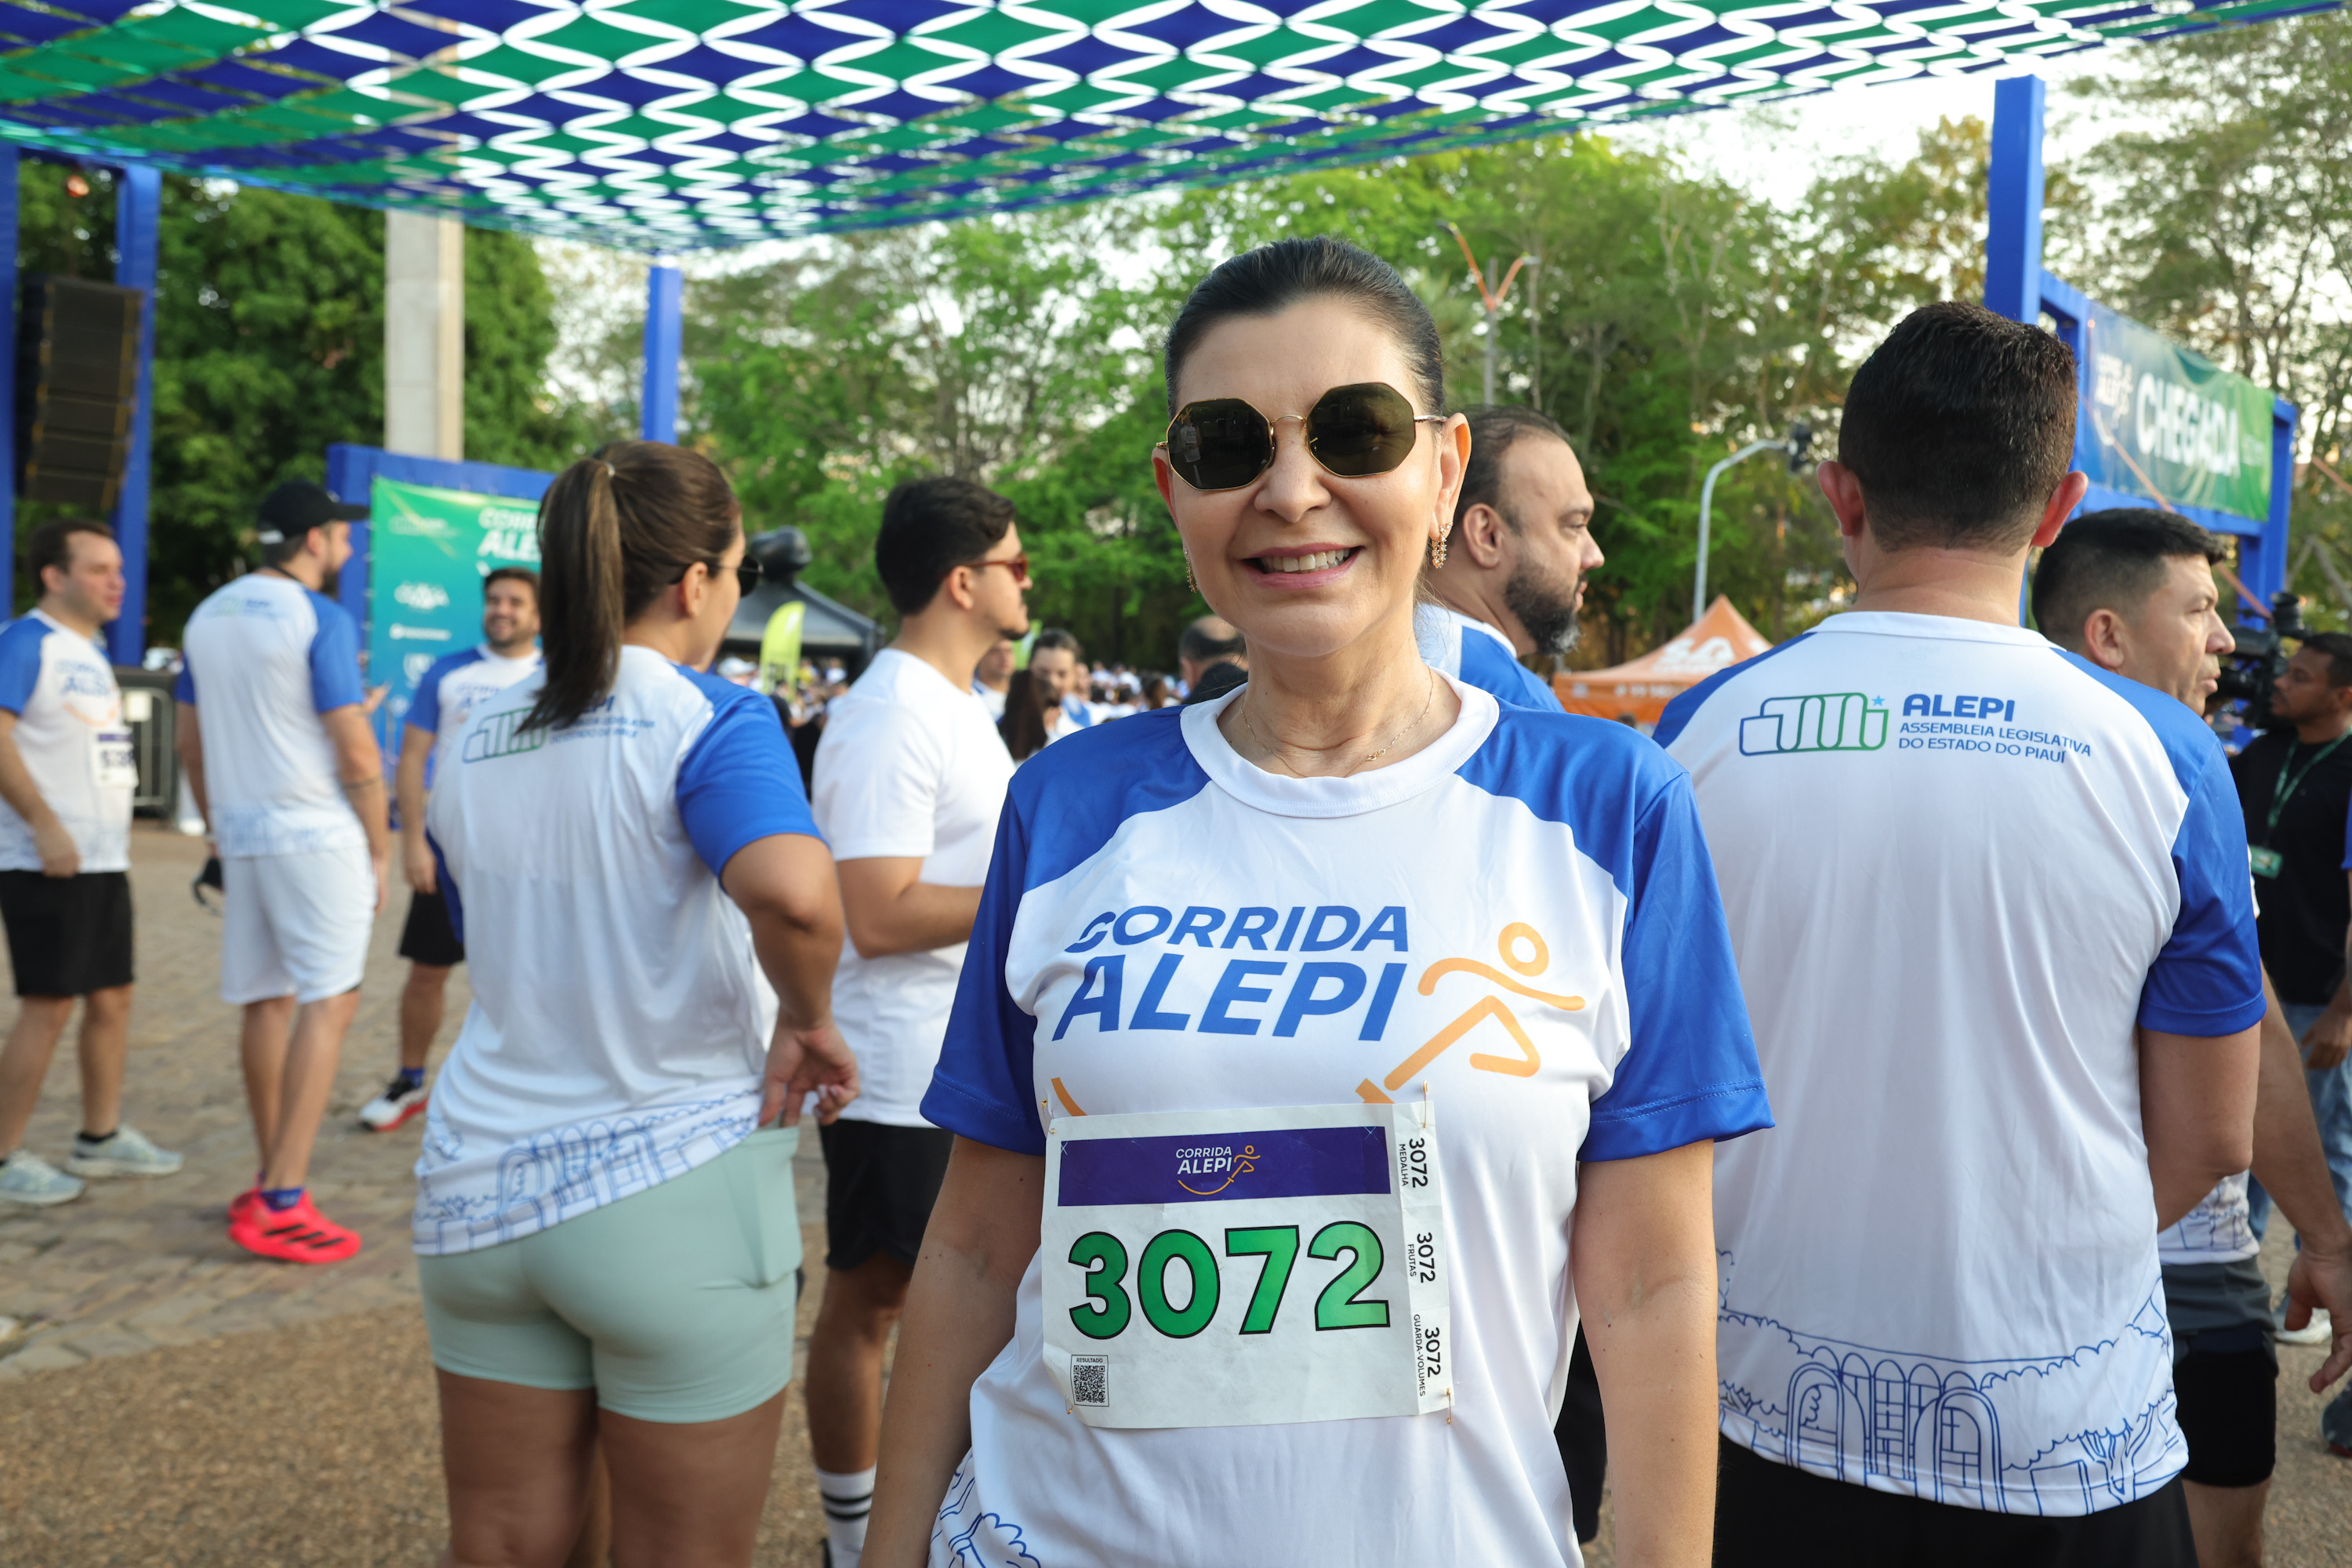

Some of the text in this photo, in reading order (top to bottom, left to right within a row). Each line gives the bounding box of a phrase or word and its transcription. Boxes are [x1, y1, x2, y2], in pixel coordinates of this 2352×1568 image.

[2136, 372, 2240, 479] CHEGADA
[476, 528, 543, 563] ALE
[1903, 694, 2015, 722] ALEPI
[1899, 738, 2067, 763] DO ESTADO DO PIAUÍ
[1900, 722, 2091, 757] ASSEMBLEIA LEGISLATIVA
[1064, 906, 1409, 953] CORRIDA
[1051, 953, 1407, 1041] ALEPI
[1176, 1146, 1232, 1158] CORRIDA
[1177, 1157, 1232, 1174] ALEPI
[1399, 1144, 1409, 1186] MEDALHA
[1409, 1138, 1428, 1188] 3072
[1407, 1243, 1417, 1277] FRUTAS
[1417, 1232, 1436, 1283] 3072
[1068, 1221, 1391, 1340] 3072
[1414, 1314, 1426, 1396] GUARDA-VOLUMES
[1425, 1327, 1441, 1377] 3072
